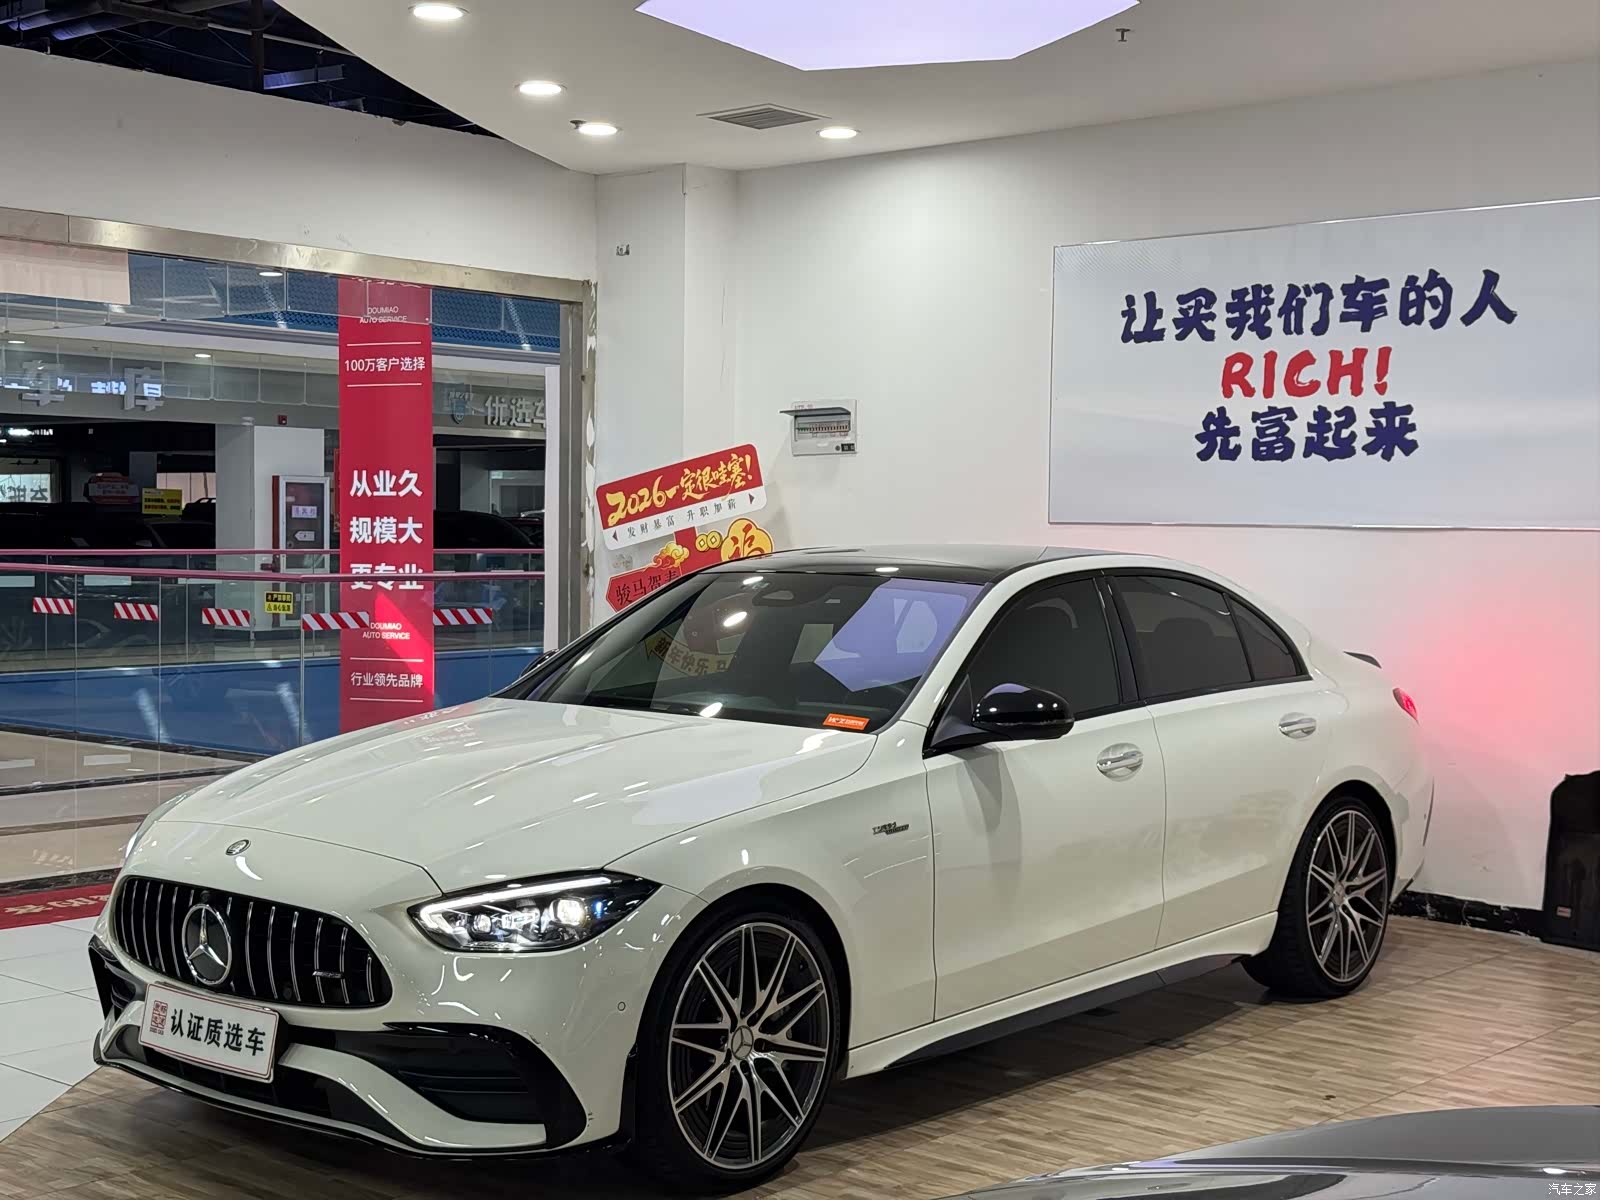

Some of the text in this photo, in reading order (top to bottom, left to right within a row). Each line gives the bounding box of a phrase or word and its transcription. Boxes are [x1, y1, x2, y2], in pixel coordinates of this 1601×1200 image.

[359, 316, 377, 324] AUTO
[367, 306, 399, 314] DOUMIAO
[1121, 269, 1517, 343] 让买我们车的人
[344, 356, 426, 372] 100万客户选择
[1222, 347, 1391, 398] RICH!
[1195, 401, 1418, 462] 先富起来
[350, 469, 423, 497] 从业久
[350, 516, 423, 545] 规模大
[350, 563, 424, 591] 更专业
[362, 631, 410, 640] AUTO SERVICE
[370, 622, 402, 630] DOUMIAO
[350, 671, 423, 688] 行业领先品牌
[170, 1008, 266, 1057] 认证质选车
